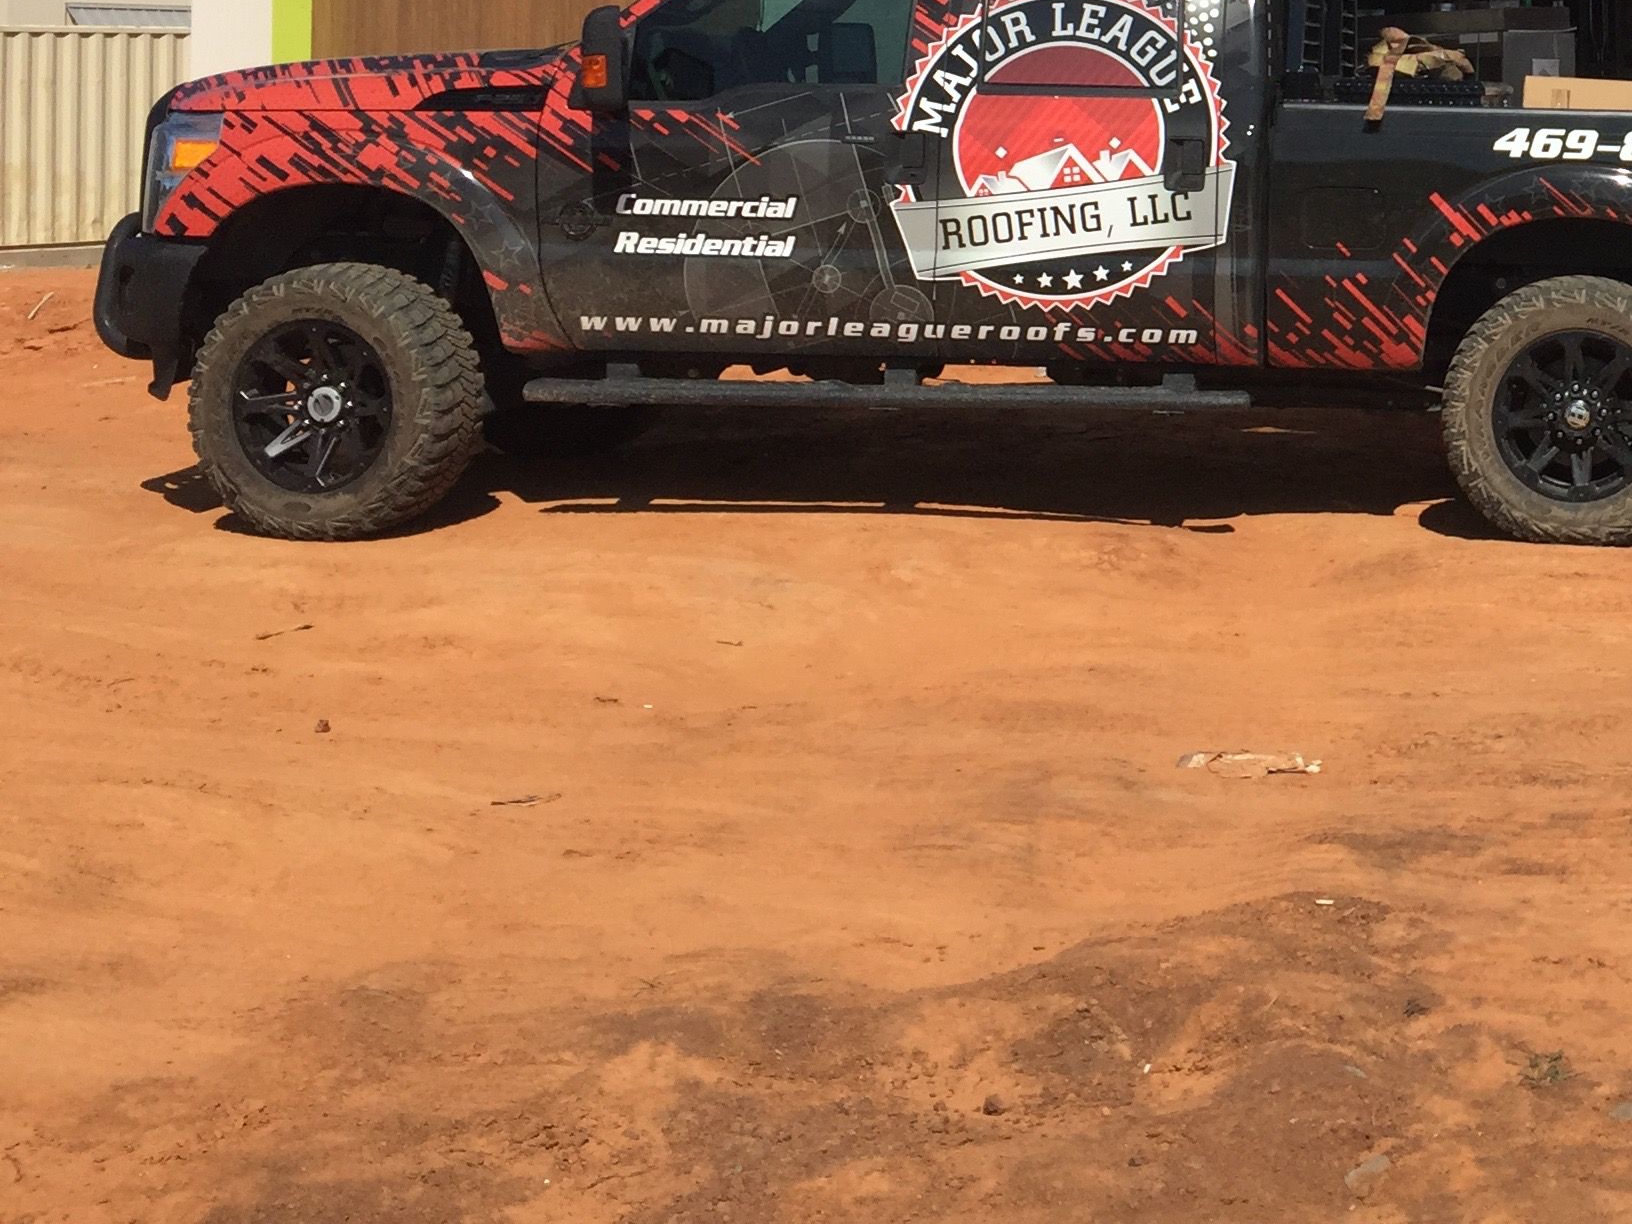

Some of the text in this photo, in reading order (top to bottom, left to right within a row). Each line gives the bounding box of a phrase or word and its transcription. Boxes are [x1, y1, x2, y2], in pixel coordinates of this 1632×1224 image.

[912, 1, 1203, 139] MAJOR LEAGUE
[614, 192, 798, 220] Commercial
[1129, 189, 1194, 228] LLC
[613, 231, 797, 259] Residential
[578, 312, 1200, 347] www.majorleagueroofs.com
